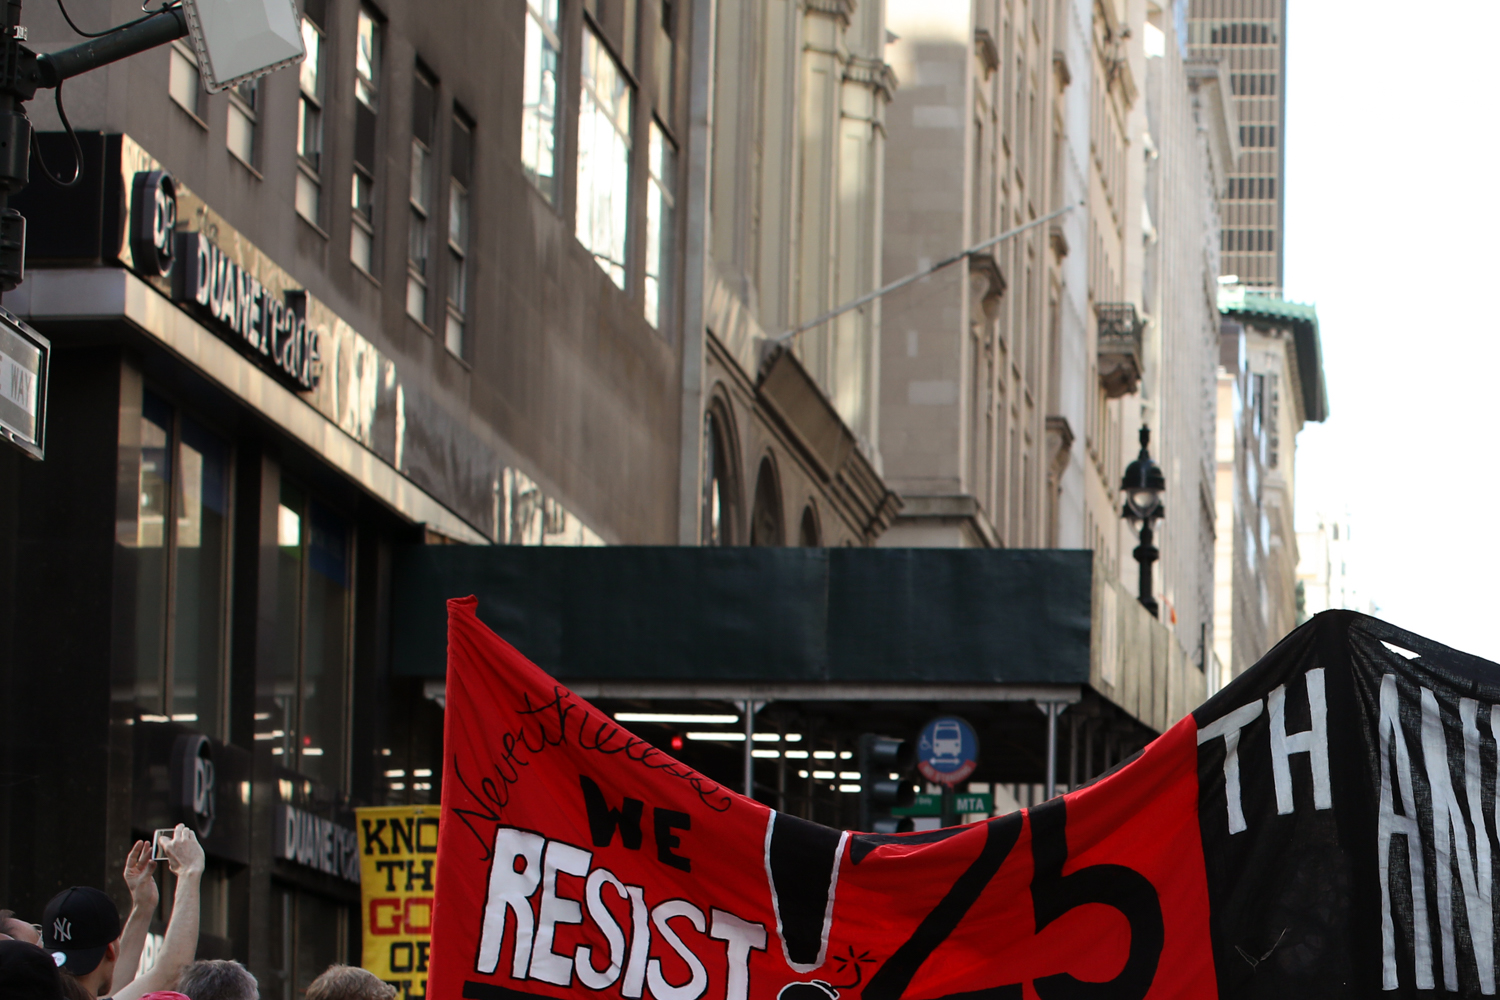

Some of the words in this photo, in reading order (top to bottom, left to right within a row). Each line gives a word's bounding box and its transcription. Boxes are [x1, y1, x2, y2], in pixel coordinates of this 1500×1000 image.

[10, 363, 32, 408] WAY
[956, 798, 985, 811] MTA
[579, 774, 692, 873] WE
[53, 917, 72, 942] NY
